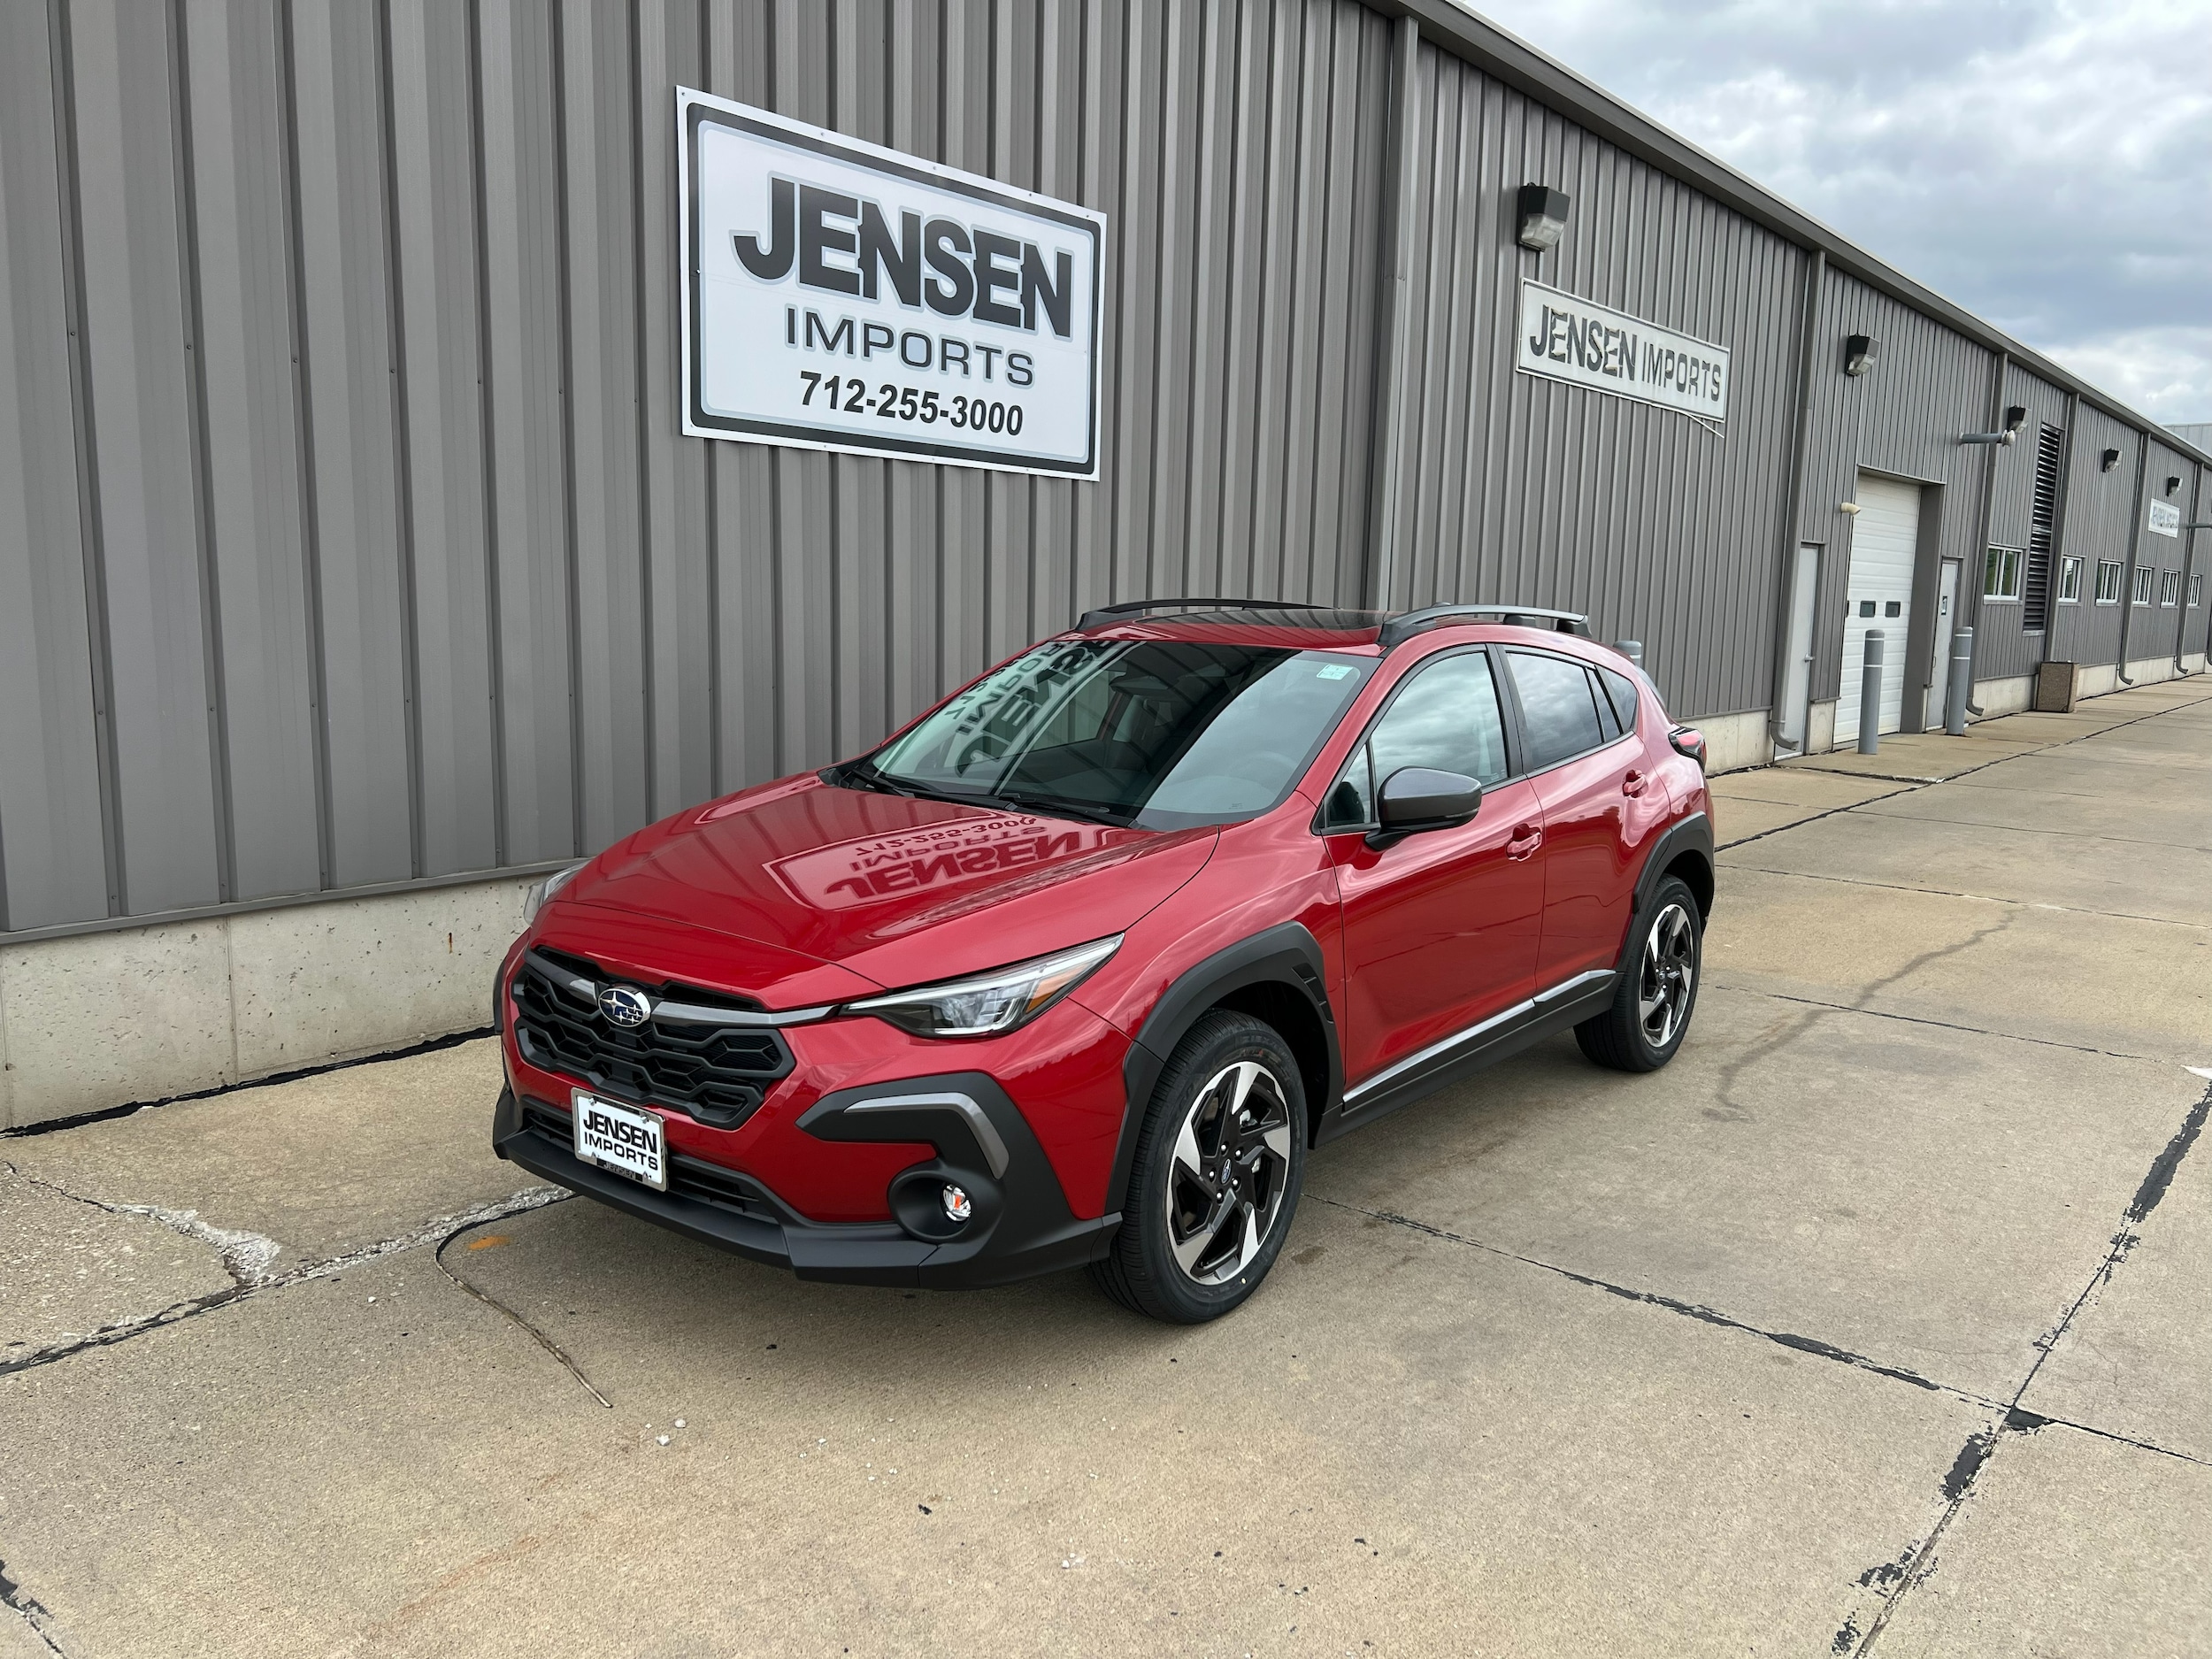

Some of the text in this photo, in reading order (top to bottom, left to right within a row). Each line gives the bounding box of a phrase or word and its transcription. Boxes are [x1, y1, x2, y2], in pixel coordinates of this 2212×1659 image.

[731, 173, 1073, 339] JENSEN
[786, 306, 1034, 387] IMPORTS
[1529, 303, 1722, 402] JENSEN IMPORTS
[799, 370, 1024, 436] 712-255-3000
[583, 1110, 657, 1155] JENSEN
[584, 1132, 658, 1171] IMPORTS
